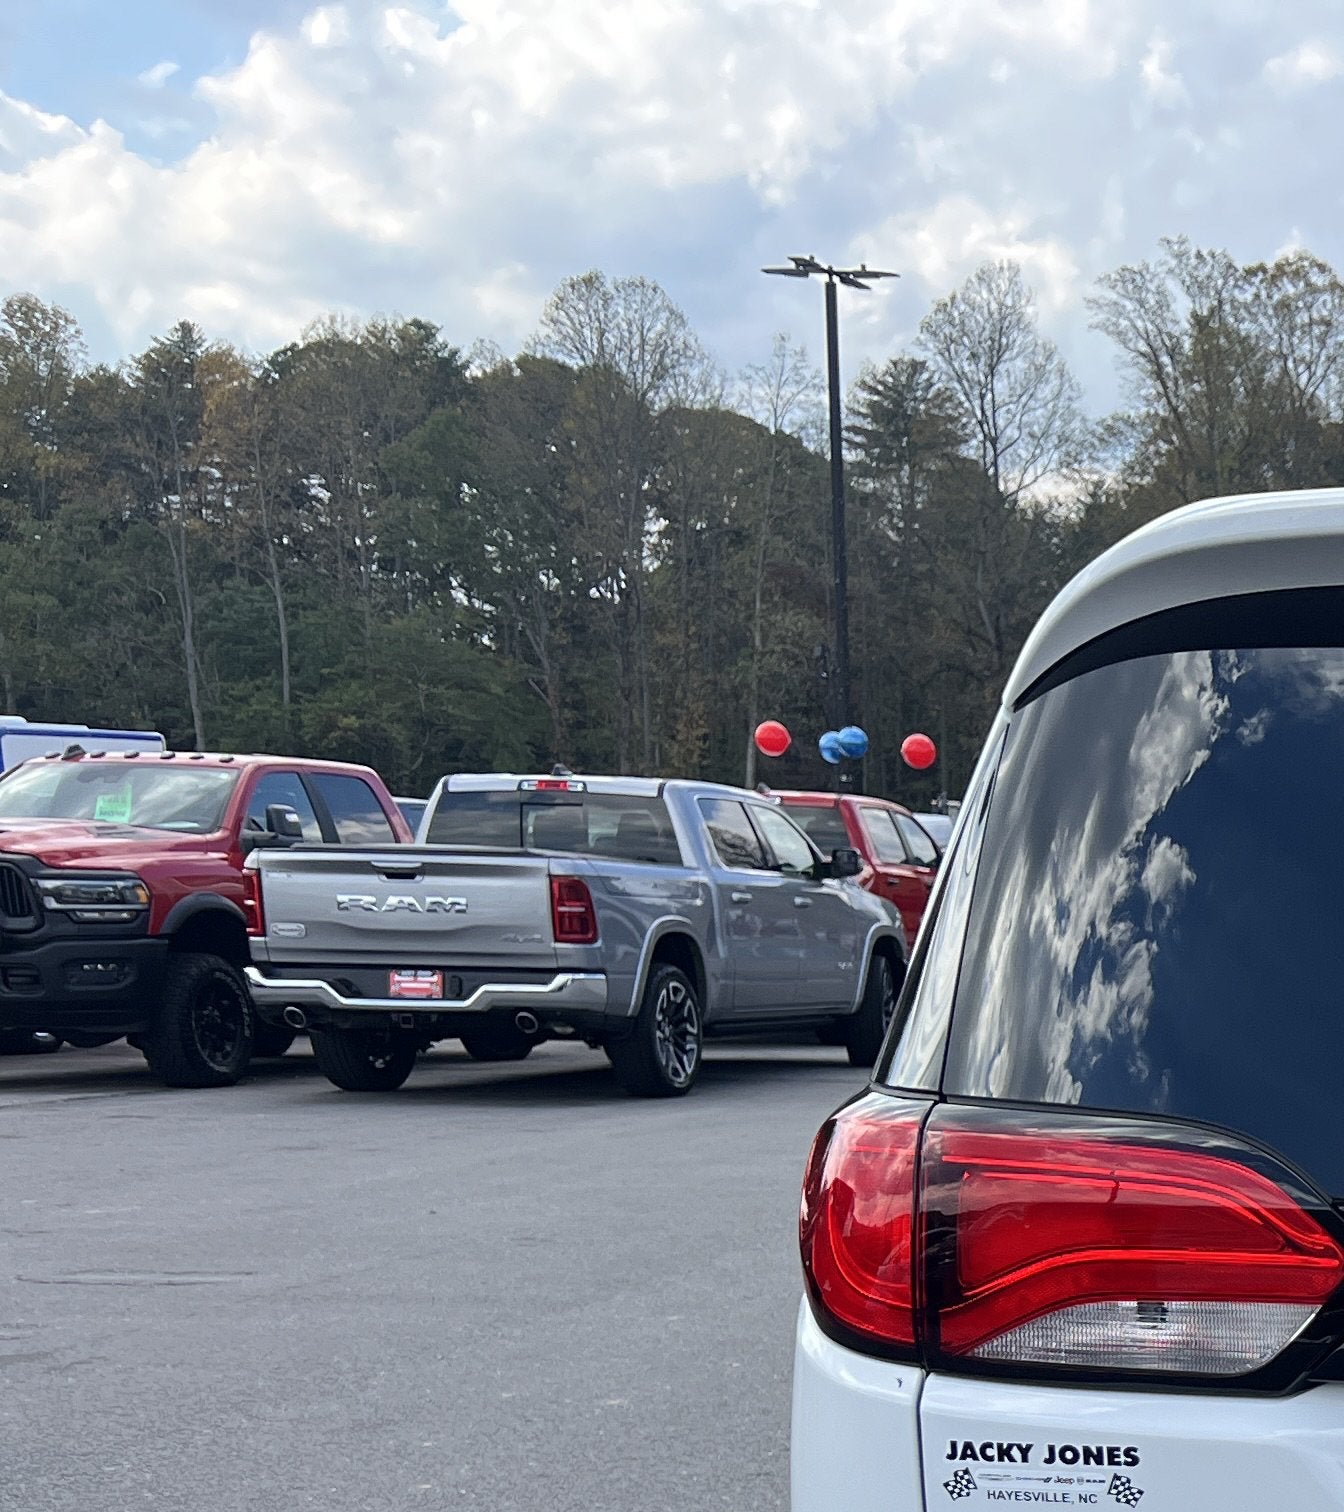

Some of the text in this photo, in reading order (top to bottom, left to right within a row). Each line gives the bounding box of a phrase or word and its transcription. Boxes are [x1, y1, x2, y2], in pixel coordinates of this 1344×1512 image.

[336, 893, 469, 913] RAM
[946, 1440, 1140, 1467] JACKY JONES
[987, 1489, 1098, 1505] HAYESVILLE, NC
